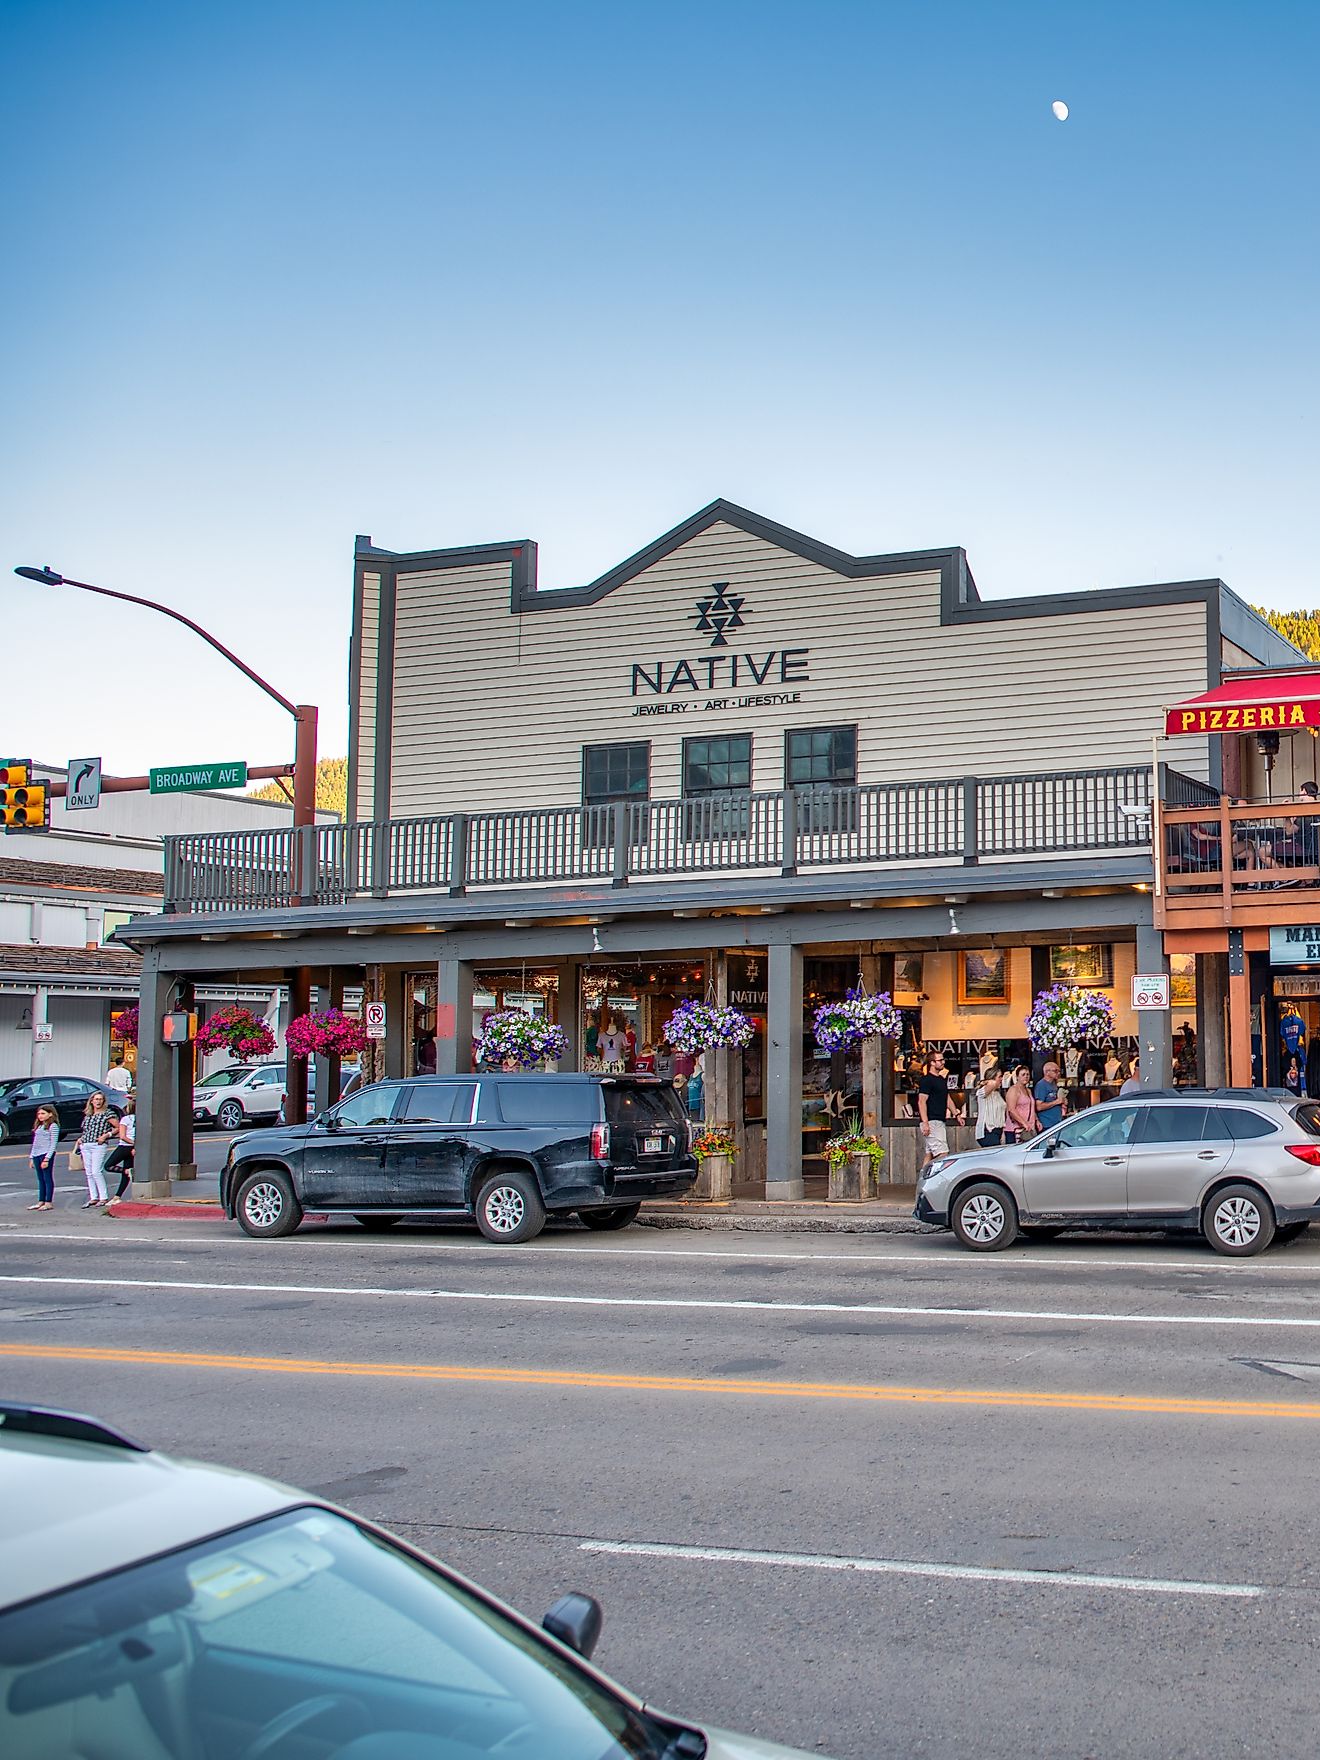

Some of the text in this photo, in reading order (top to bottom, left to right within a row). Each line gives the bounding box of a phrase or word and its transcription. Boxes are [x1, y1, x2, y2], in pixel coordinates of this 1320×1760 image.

[632, 648, 809, 696] NATIVE
[632, 693, 801, 716] JEWELRY ART LIFESTYLE
[1181, 704, 1306, 731] PIZZERIA
[156, 768, 239, 788] BROADWAY AVE
[71, 794, 95, 806] ONLY
[927, 1039, 998, 1054] NATIVE
